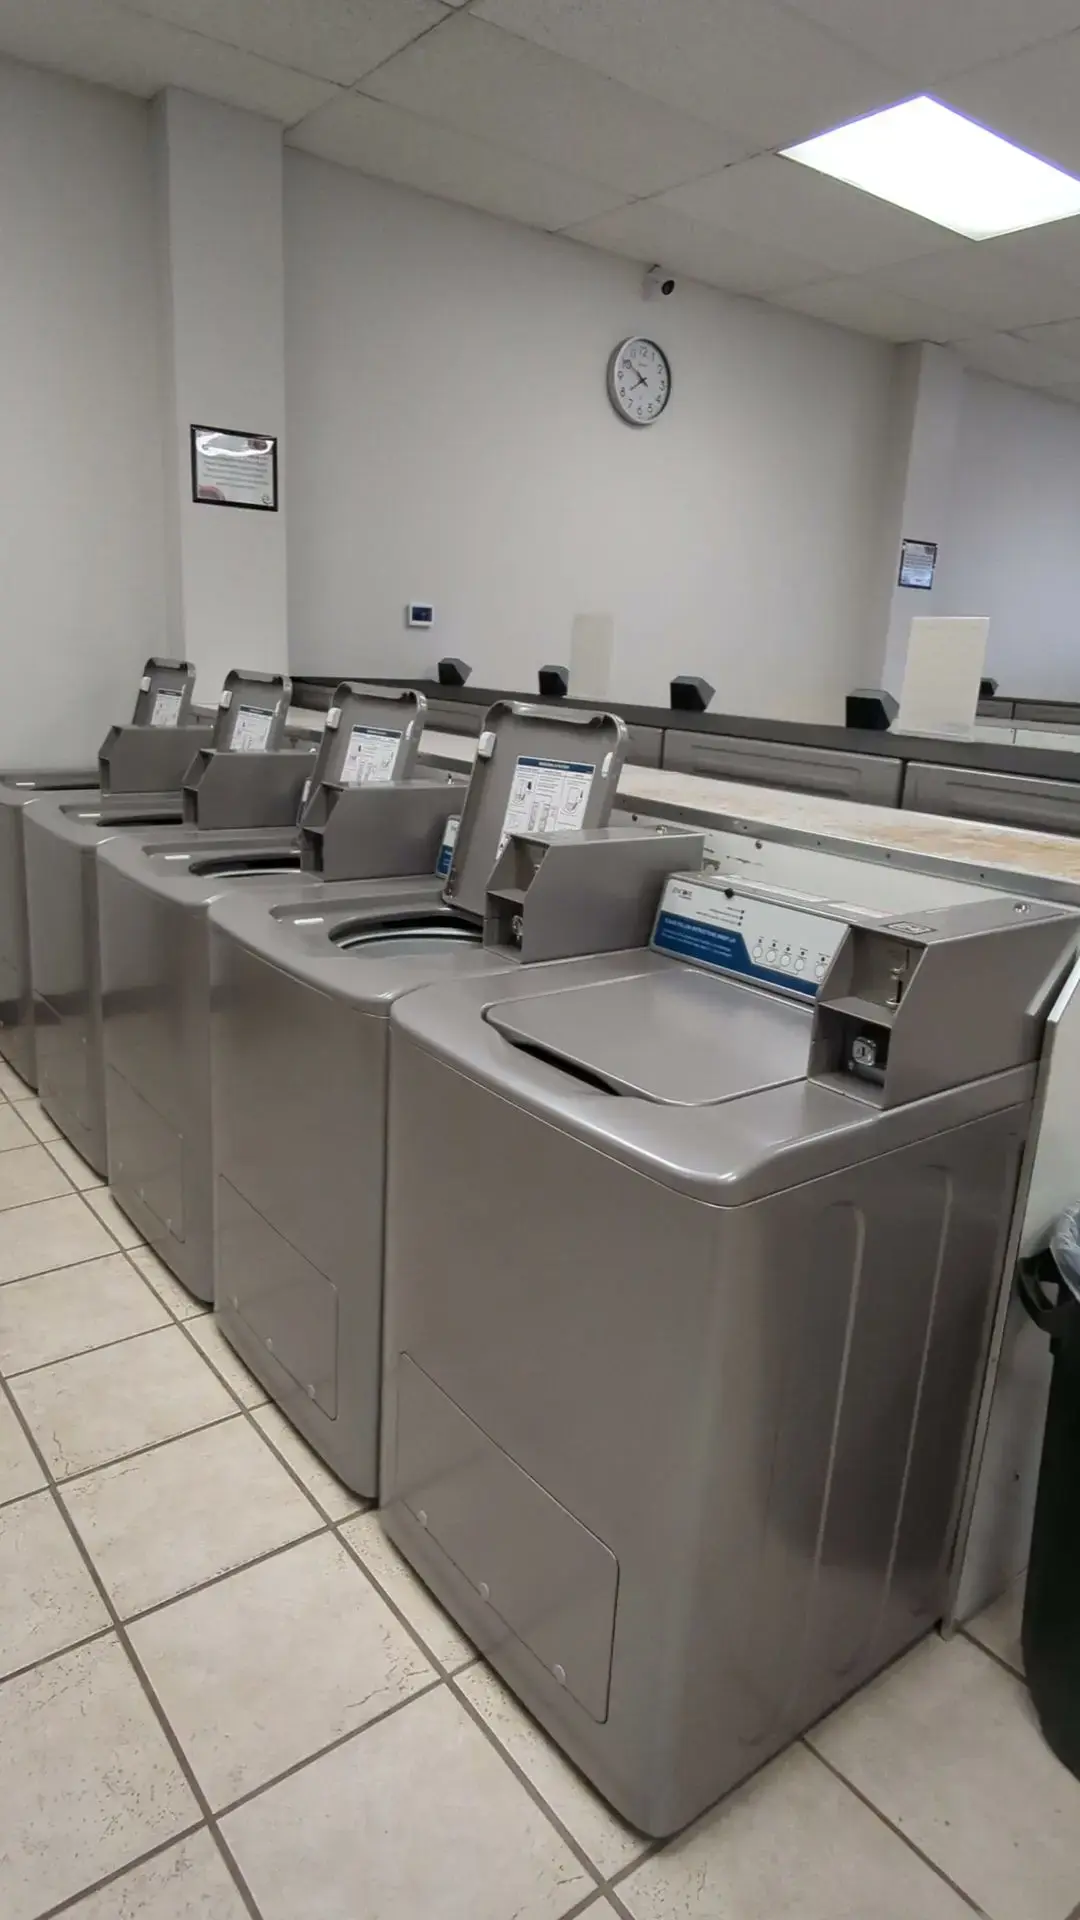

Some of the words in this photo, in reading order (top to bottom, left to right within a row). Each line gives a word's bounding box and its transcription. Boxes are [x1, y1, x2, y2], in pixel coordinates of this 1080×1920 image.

[657, 364, 664, 374] 2
[617, 370, 624, 380] 9
[620, 386, 626, 398] 8
[628, 398, 634, 408] 7
[656, 394, 662, 404] 4
[637, 406, 642, 415] 6
[647, 403, 653, 413] 5
